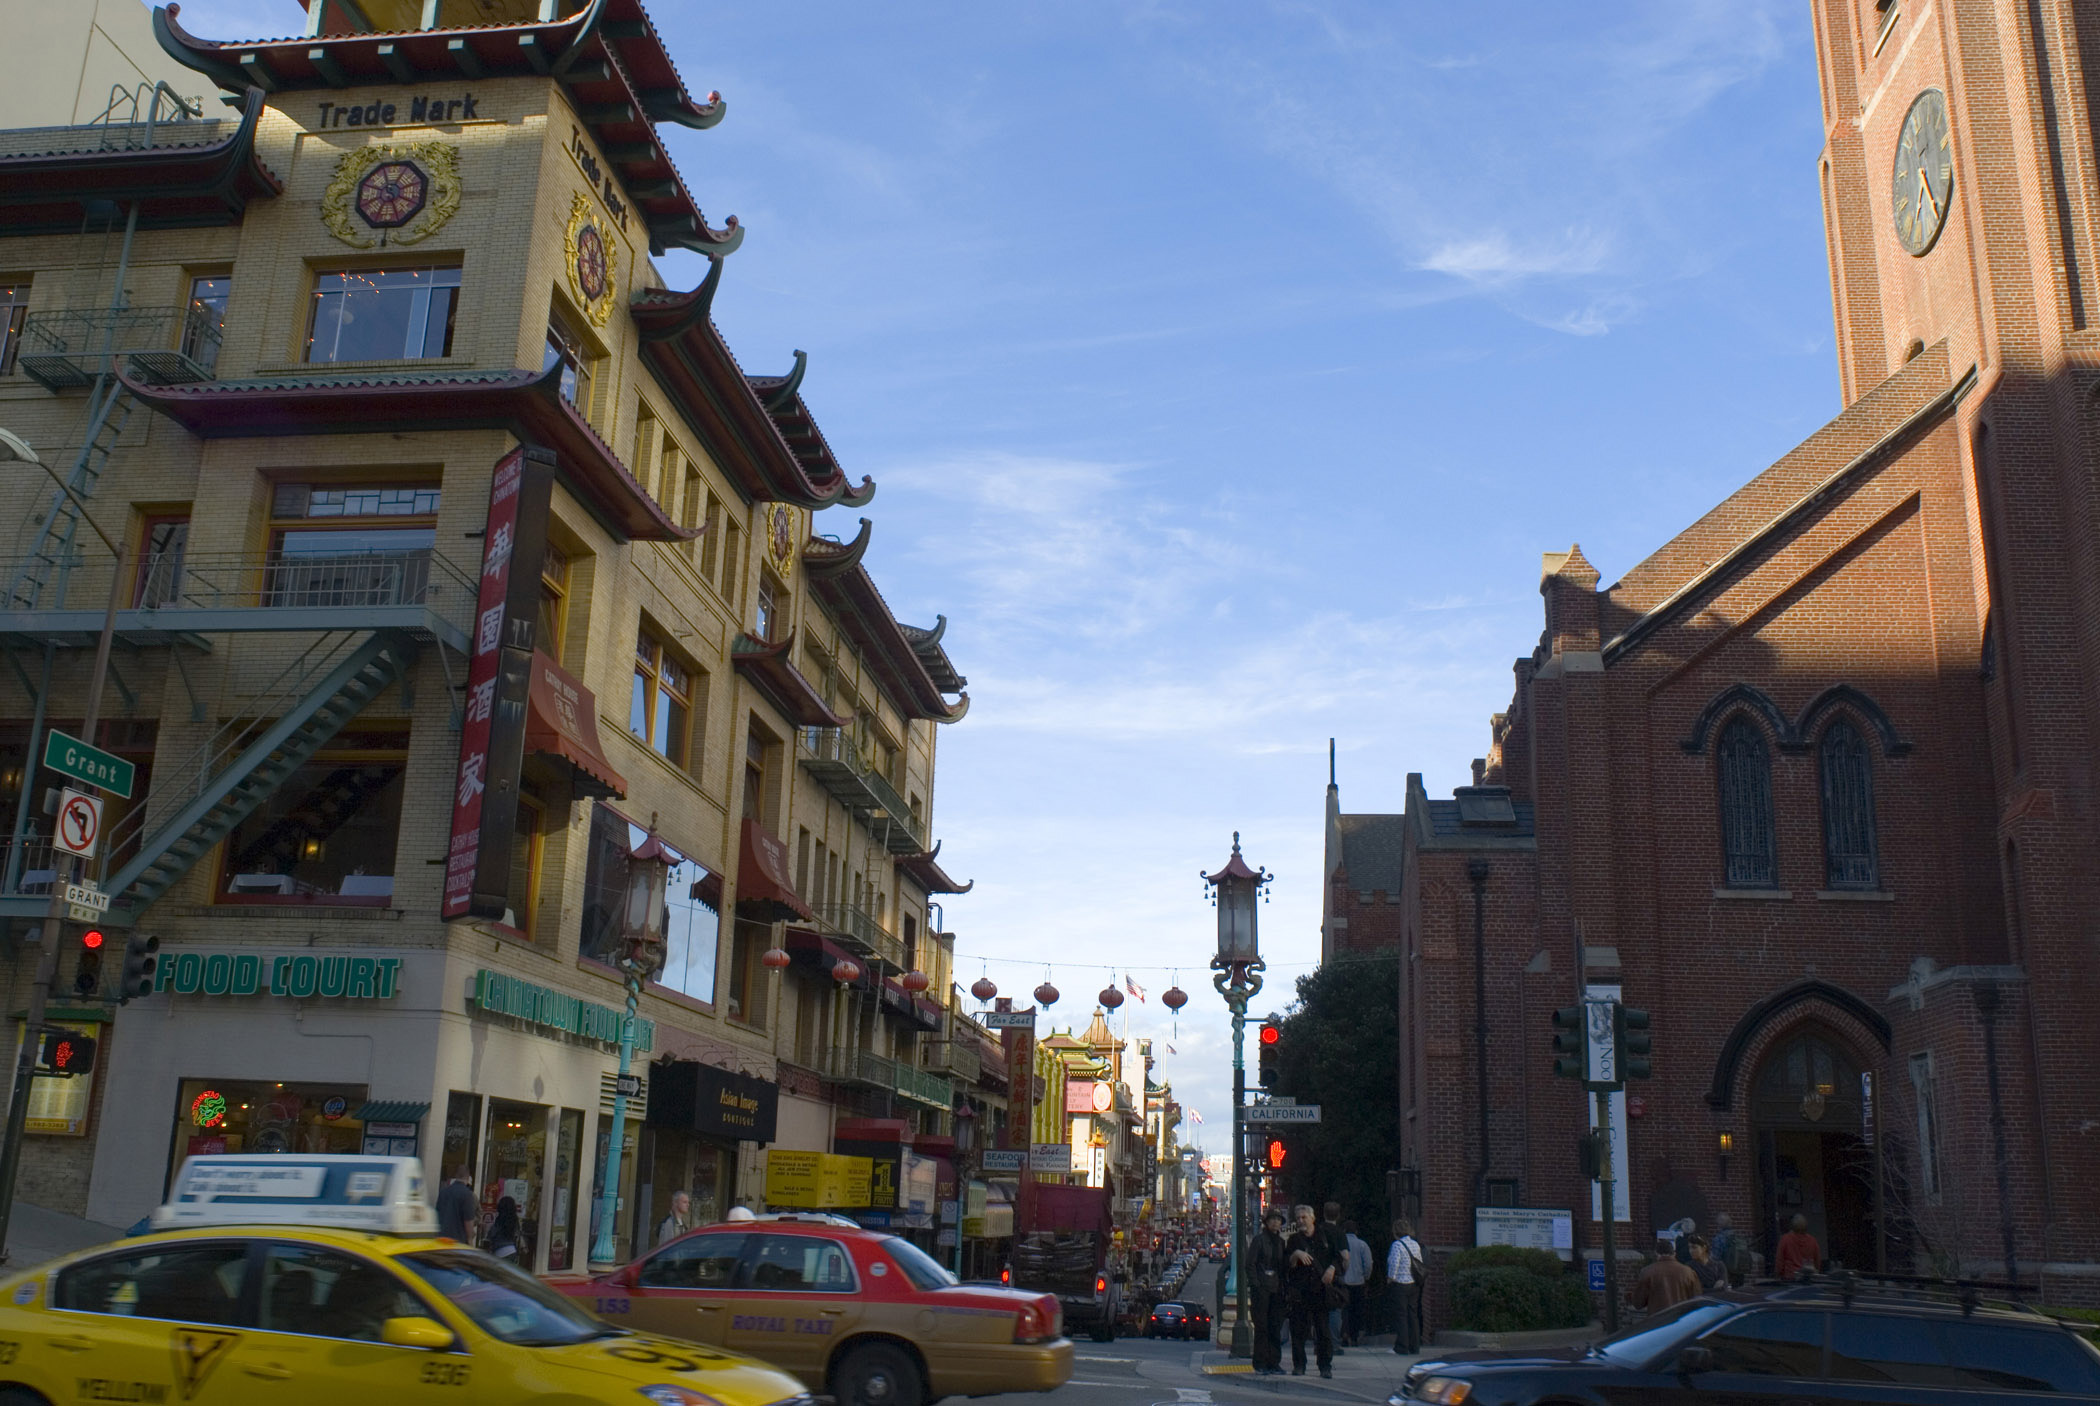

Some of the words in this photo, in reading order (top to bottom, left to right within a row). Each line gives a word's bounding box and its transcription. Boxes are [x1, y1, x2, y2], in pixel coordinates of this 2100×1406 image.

[319, 98, 396, 128] Trade
[411, 93, 479, 122] Mark
[572, 125, 600, 188] Trade
[604, 177, 628, 233] Mark
[494, 458, 516, 487] WELCOME
[493, 474, 521, 505] CHINATOWN
[545, 669, 562, 693] CATHAY
[563, 682, 579, 705] HOUSE
[65, 747, 117, 784] Grant
[69, 886, 107, 909] GRANT
[153, 953, 262, 996] FOOD
[270, 954, 400, 999] COURT
[483, 969, 580, 1034] CHINATOWN
[581, 1000, 617, 1044] FOOD
[991, 1015, 1006, 1024] Far
[1009, 1014, 1030, 1025] East
[192, 1090, 220, 1110] TSINGTAO
[720, 1088, 738, 1107] Asian
[740, 1092, 758, 1114] Image
[205, 1112, 224, 1128] BEER
[723, 1113, 755, 1127] BOUTIQUE
[1251, 1109, 1315, 1119] CALIFORNIA
[986, 1153, 1025, 1162] SEAFOOD
[1040, 1145, 1059, 1155] East
[875, 1161, 895, 1193] 1
[874, 1196, 894, 1206] PHOTO
[1512, 1210, 1535, 1218] Mary's
[597, 1299, 631, 1314] 153
[733, 1315, 786, 1332] ROYAL
[795, 1318, 835, 1335] TAXI
